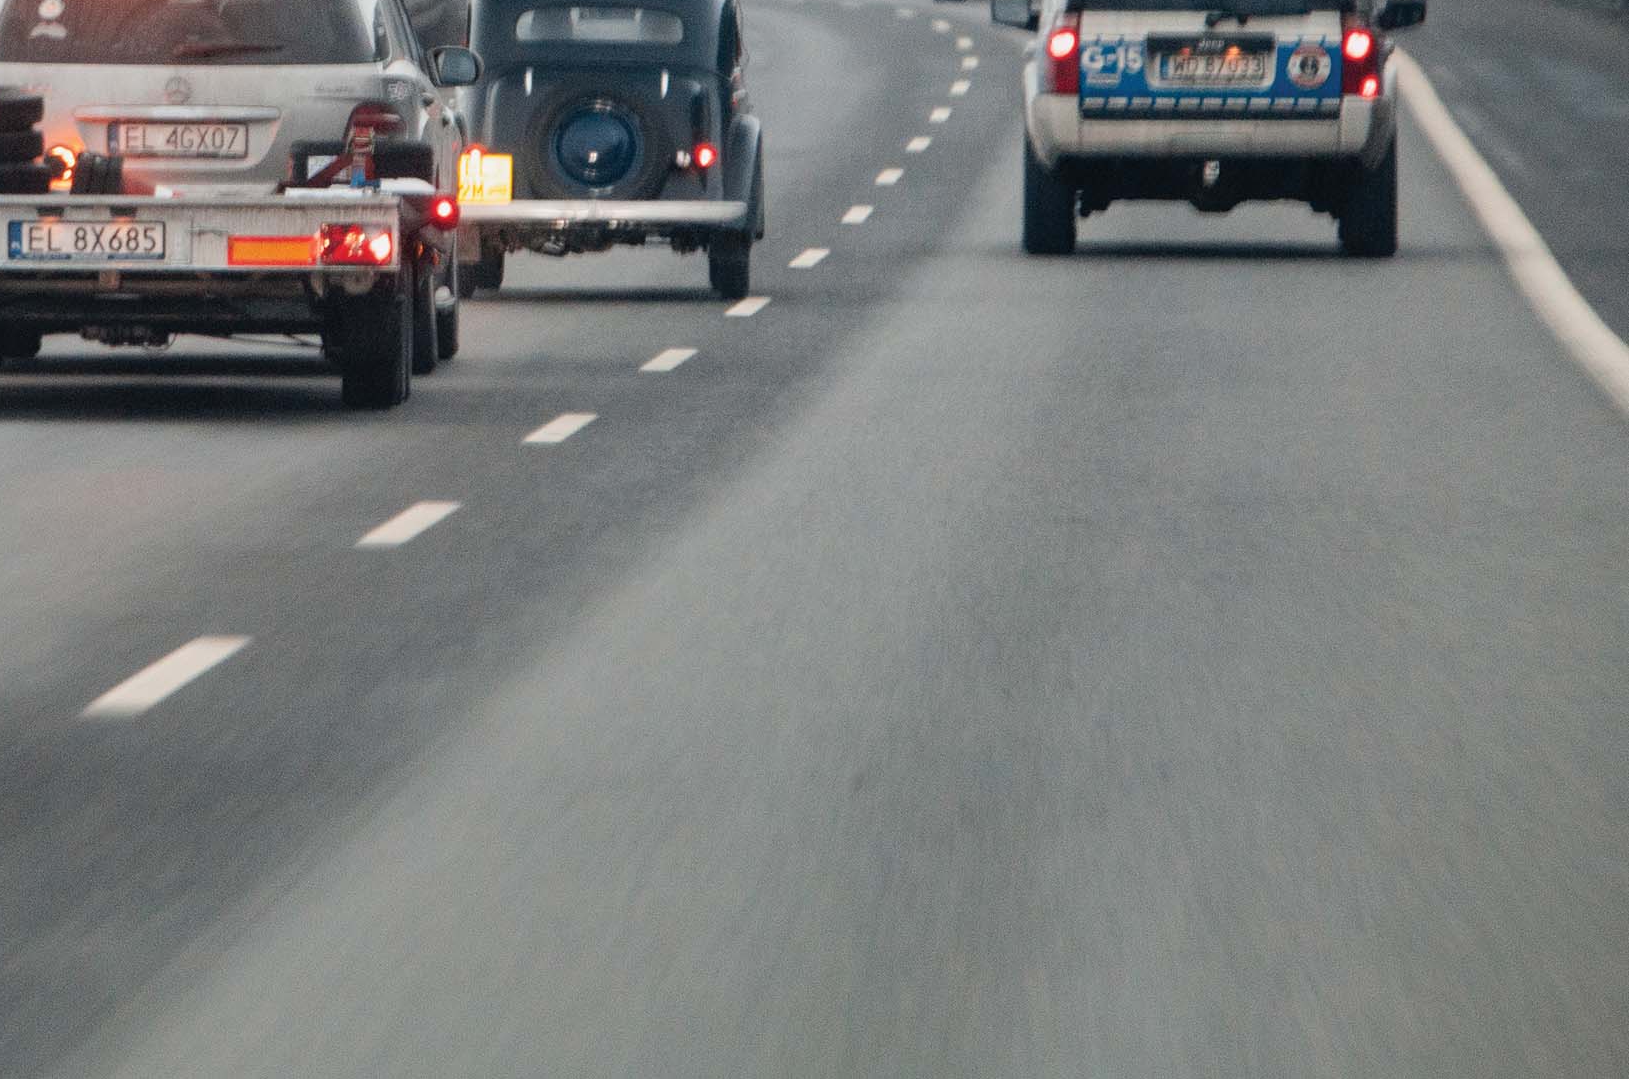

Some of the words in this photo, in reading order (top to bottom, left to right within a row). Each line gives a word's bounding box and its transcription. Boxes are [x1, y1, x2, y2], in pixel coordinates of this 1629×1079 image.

[125, 126, 155, 150] EL
[165, 126, 240, 150] 4GX07
[28, 226, 62, 252] EL
[73, 226, 156, 252] 8X685
